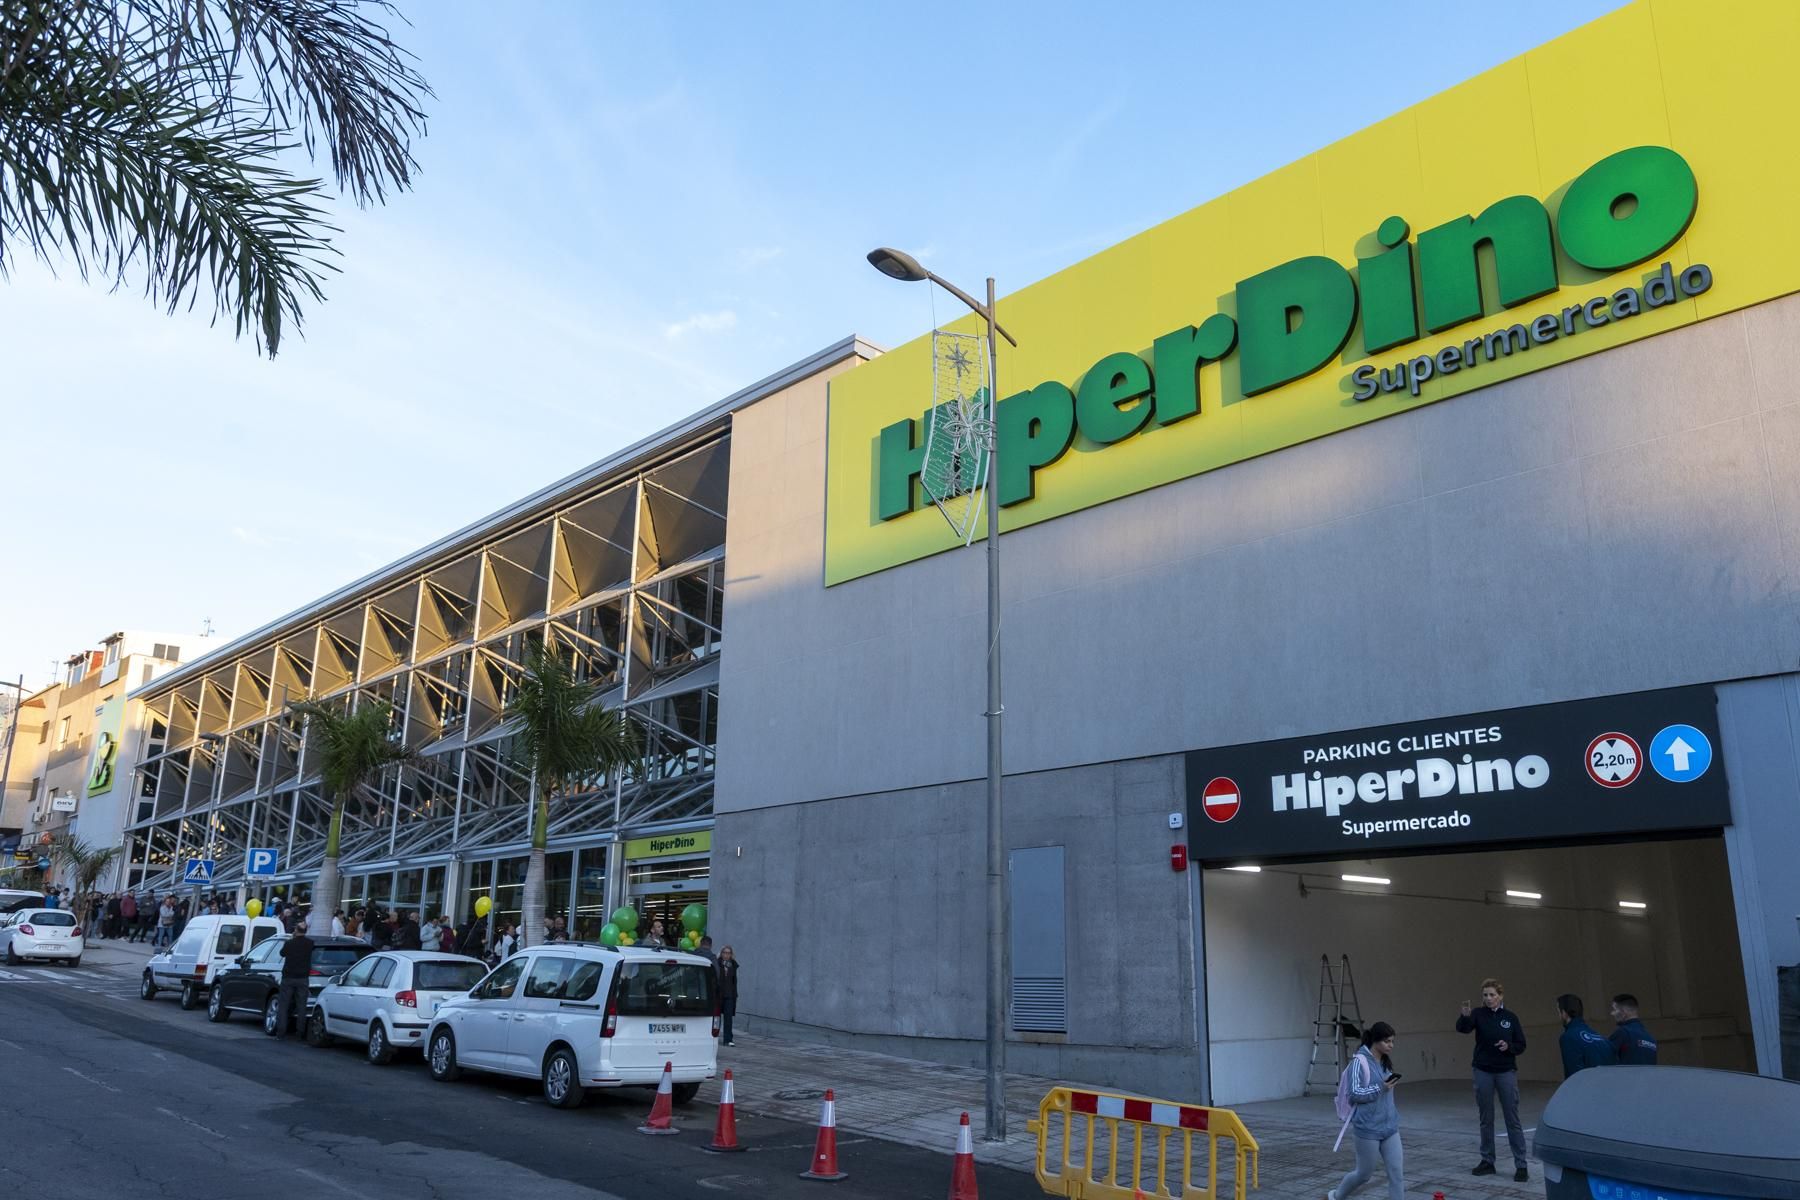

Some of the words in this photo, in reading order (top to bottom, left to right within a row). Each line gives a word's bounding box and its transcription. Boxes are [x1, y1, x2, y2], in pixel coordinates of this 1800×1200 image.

[879, 145, 1698, 523] HiperDino
[1352, 261, 1713, 402] Supermercado
[1303, 740, 1391, 764] PARKING
[1397, 726, 1502, 753] CLIENTES
[1271, 753, 1550, 817] HiperDino
[1342, 810, 1471, 839] Supermercado
[253, 851, 272, 872] P
[650, 837, 695, 853] HiperDino
